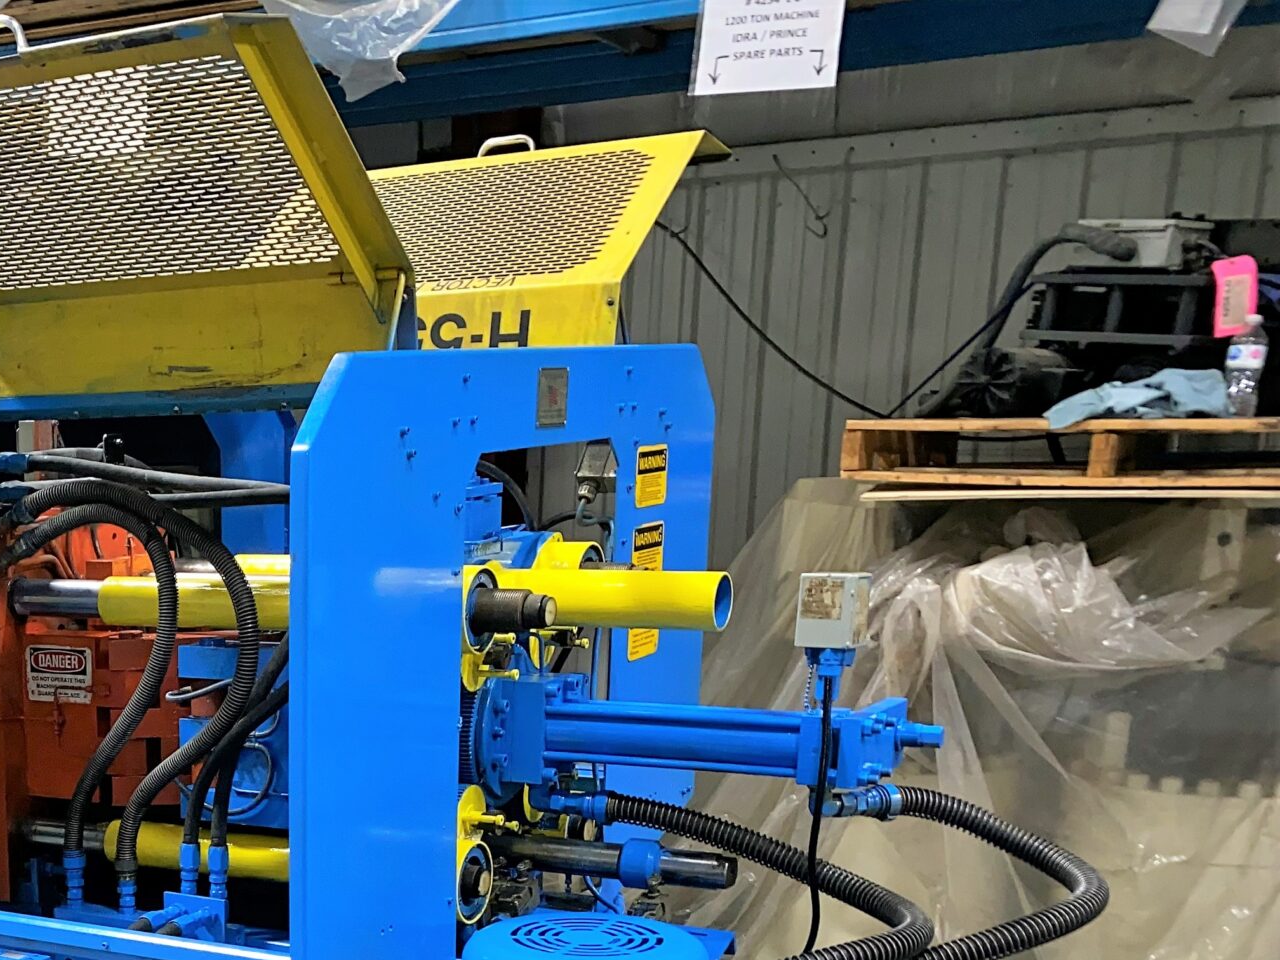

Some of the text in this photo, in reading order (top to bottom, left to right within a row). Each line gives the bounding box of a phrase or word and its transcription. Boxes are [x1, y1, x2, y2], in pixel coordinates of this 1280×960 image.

[725, 10, 820, 26] 1200 TON MACHINE
[732, 32, 758, 43] IDRA
[769, 28, 808, 39] PRINCE
[733, 47, 804, 61] SPARE PARTS
[639, 454, 666, 470] WARNING
[635, 529, 662, 547] WARNING
[38, 653, 79, 669] DANGER
